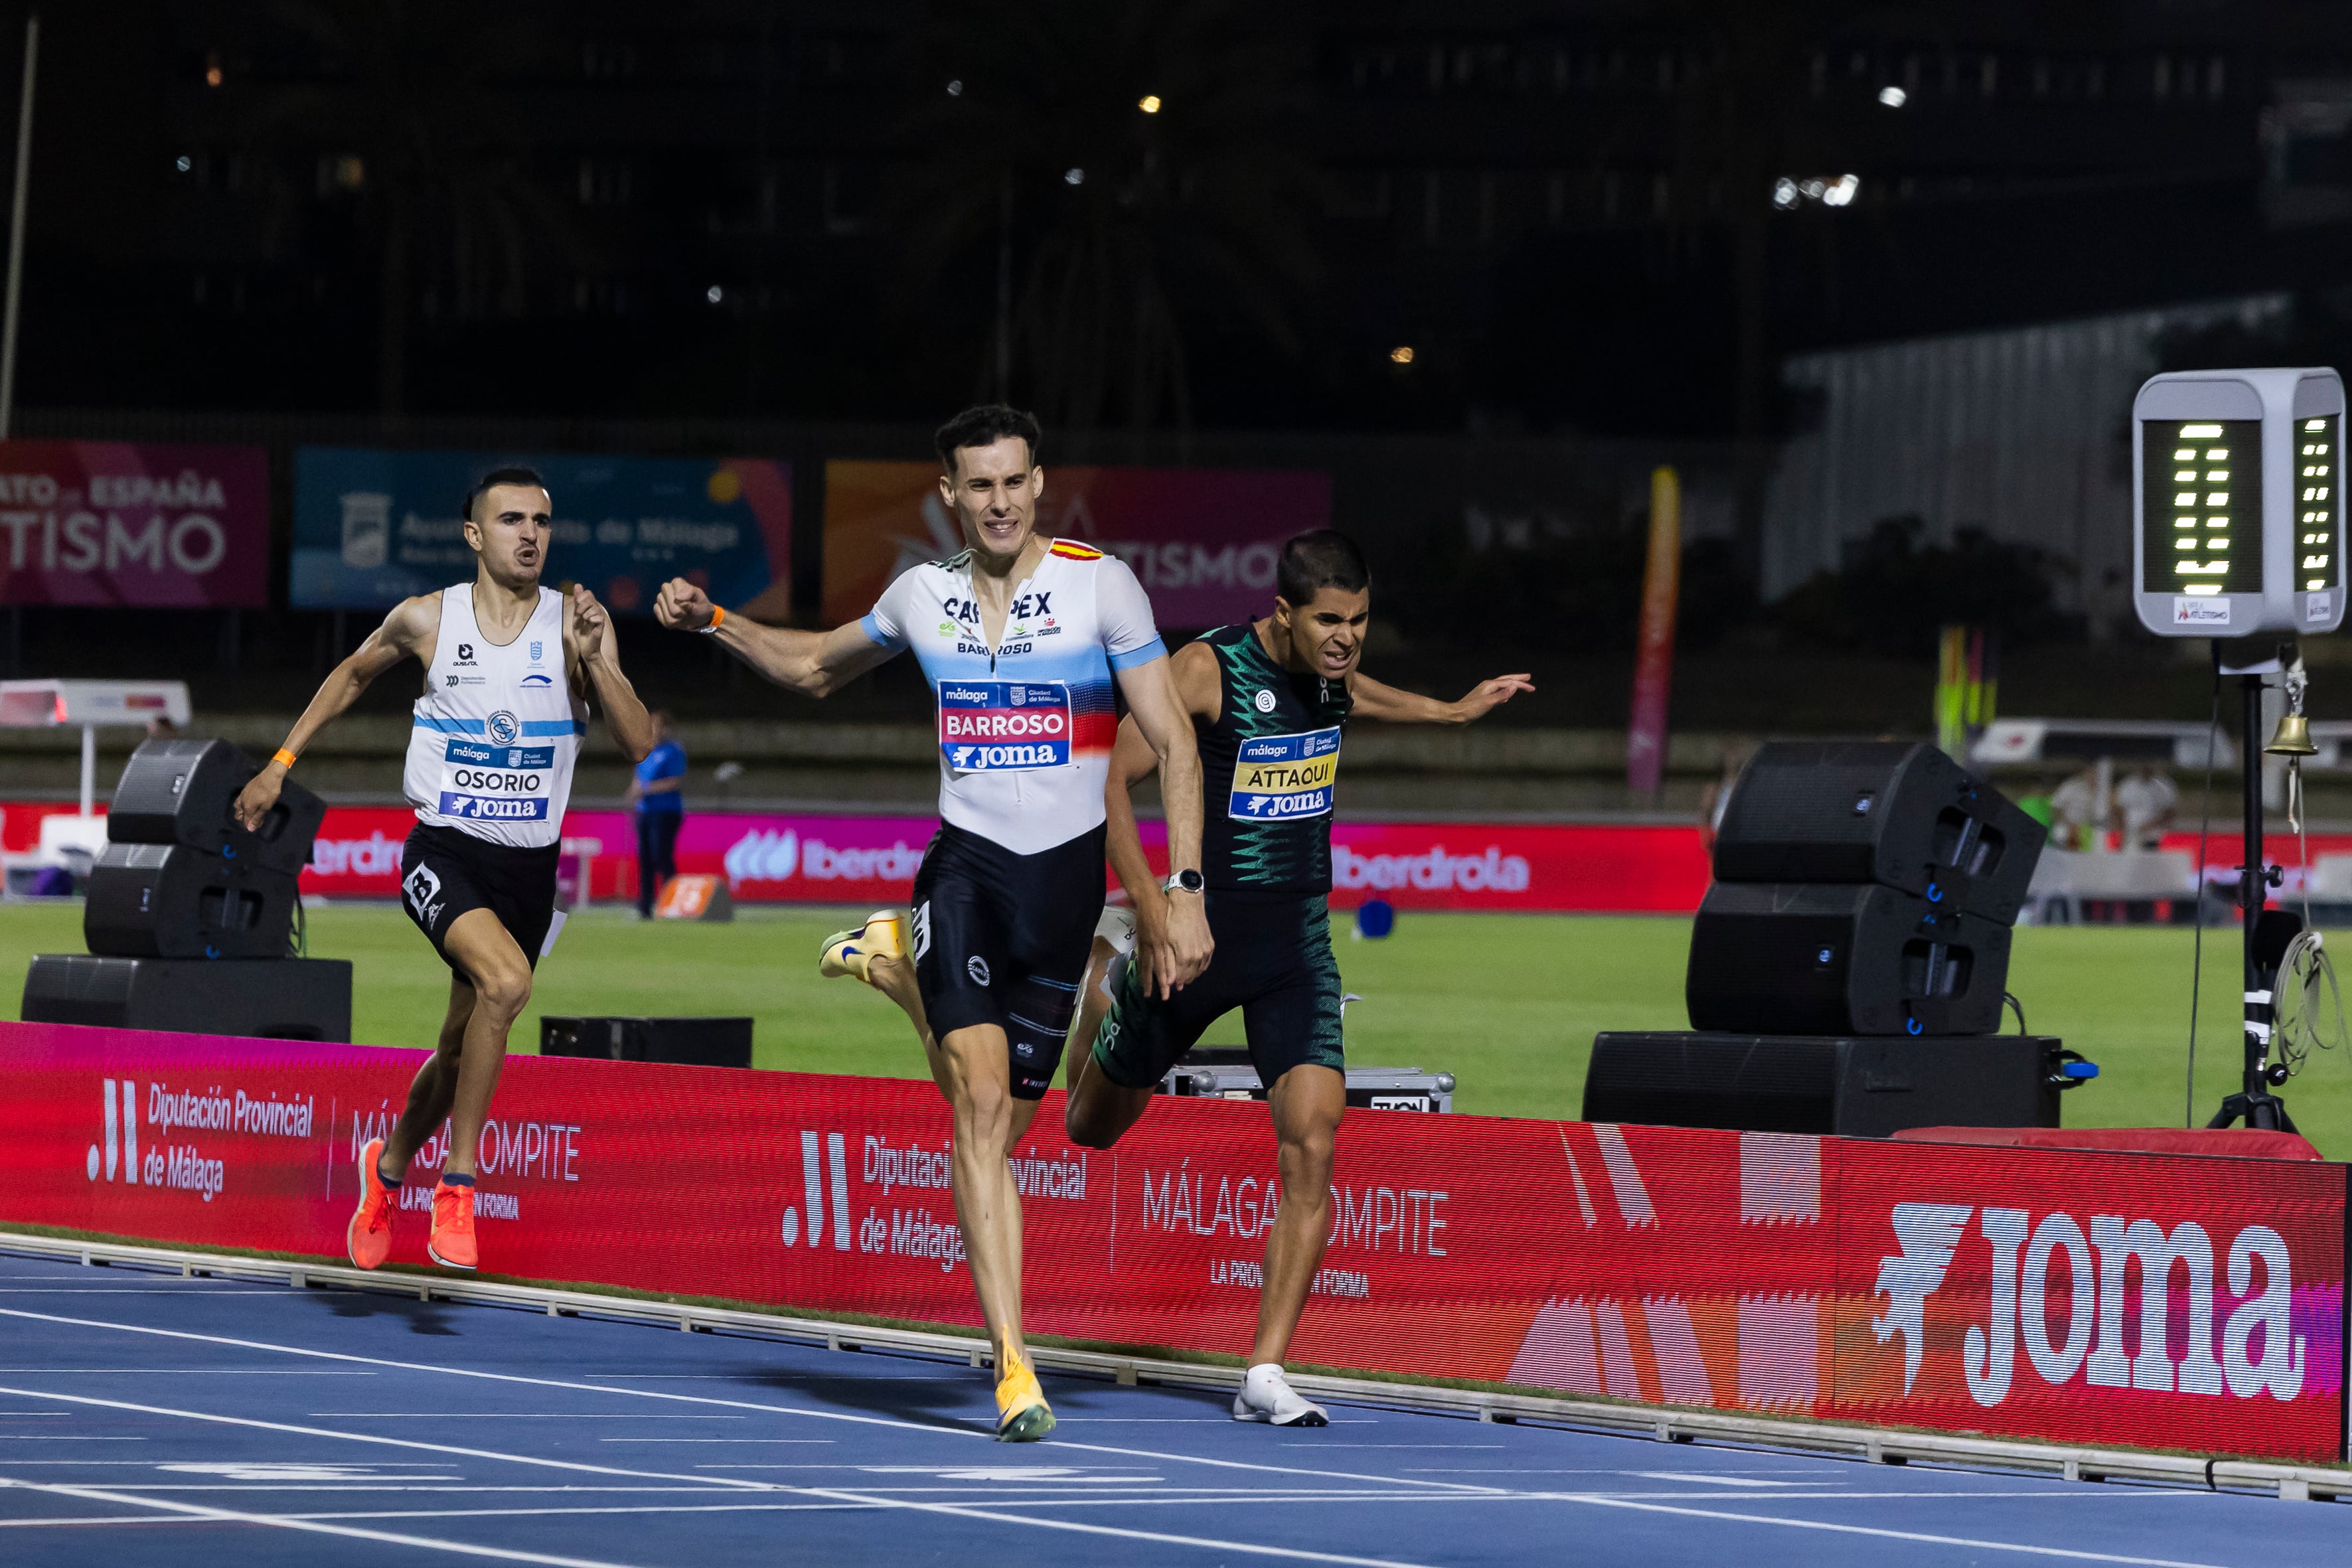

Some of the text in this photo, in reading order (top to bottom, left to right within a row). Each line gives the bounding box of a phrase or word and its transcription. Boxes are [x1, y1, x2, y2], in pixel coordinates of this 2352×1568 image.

[946, 714, 1063, 736] BARROSO
[455, 769, 540, 792] OSORIO
[148, 1081, 313, 1137] Diputación Provincial
[143, 1144, 224, 1202] de Málaga
[475, 1119, 582, 1181] OMPITE
[862, 1135, 1087, 1200] Diputaci vincial
[400, 1185, 414, 1211] LA
[1327, 1185, 1449, 1256] OMPITE
[859, 1206, 888, 1254] de
[1210, 1259, 1228, 1285] LA
